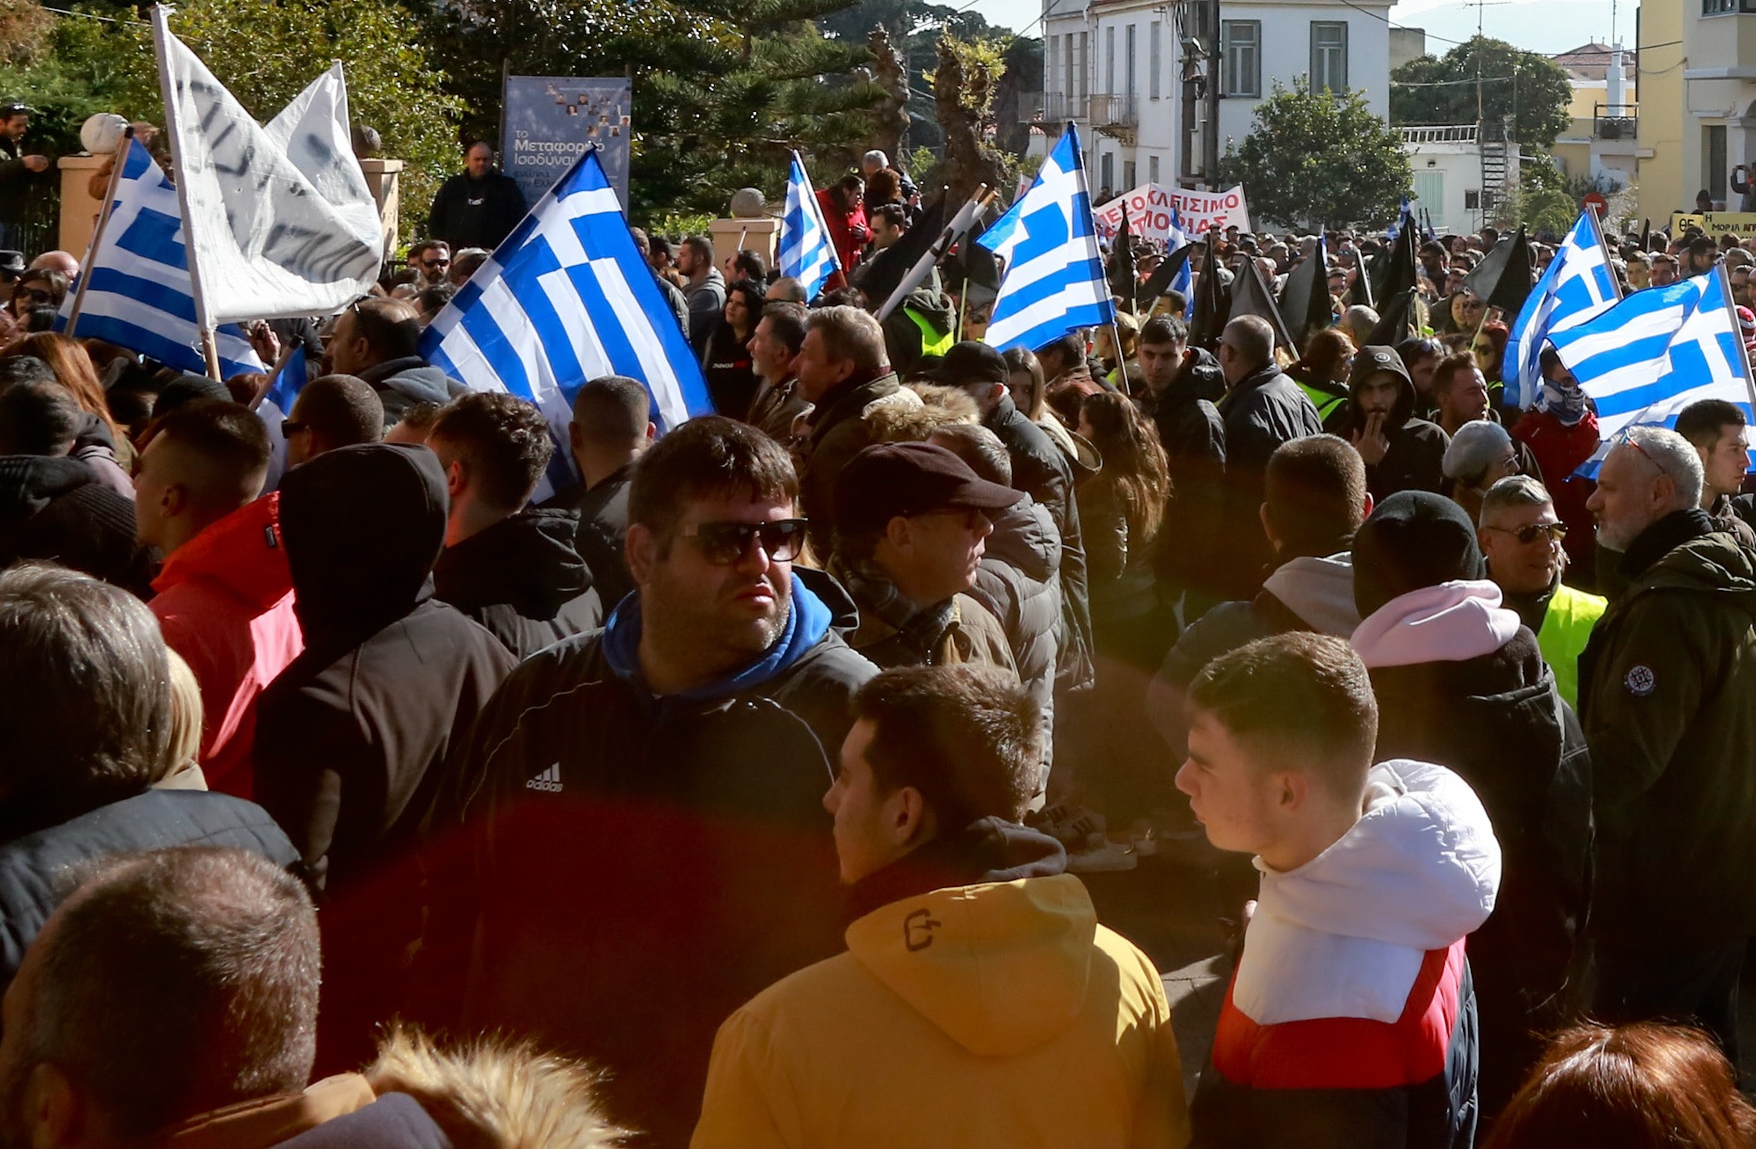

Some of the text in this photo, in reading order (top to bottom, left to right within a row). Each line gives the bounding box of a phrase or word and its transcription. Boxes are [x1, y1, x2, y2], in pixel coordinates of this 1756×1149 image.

[515, 138, 605, 154] Μεταφορό
[515, 153, 575, 167] Ισοδύνα
[526, 779, 564, 793] adidas
